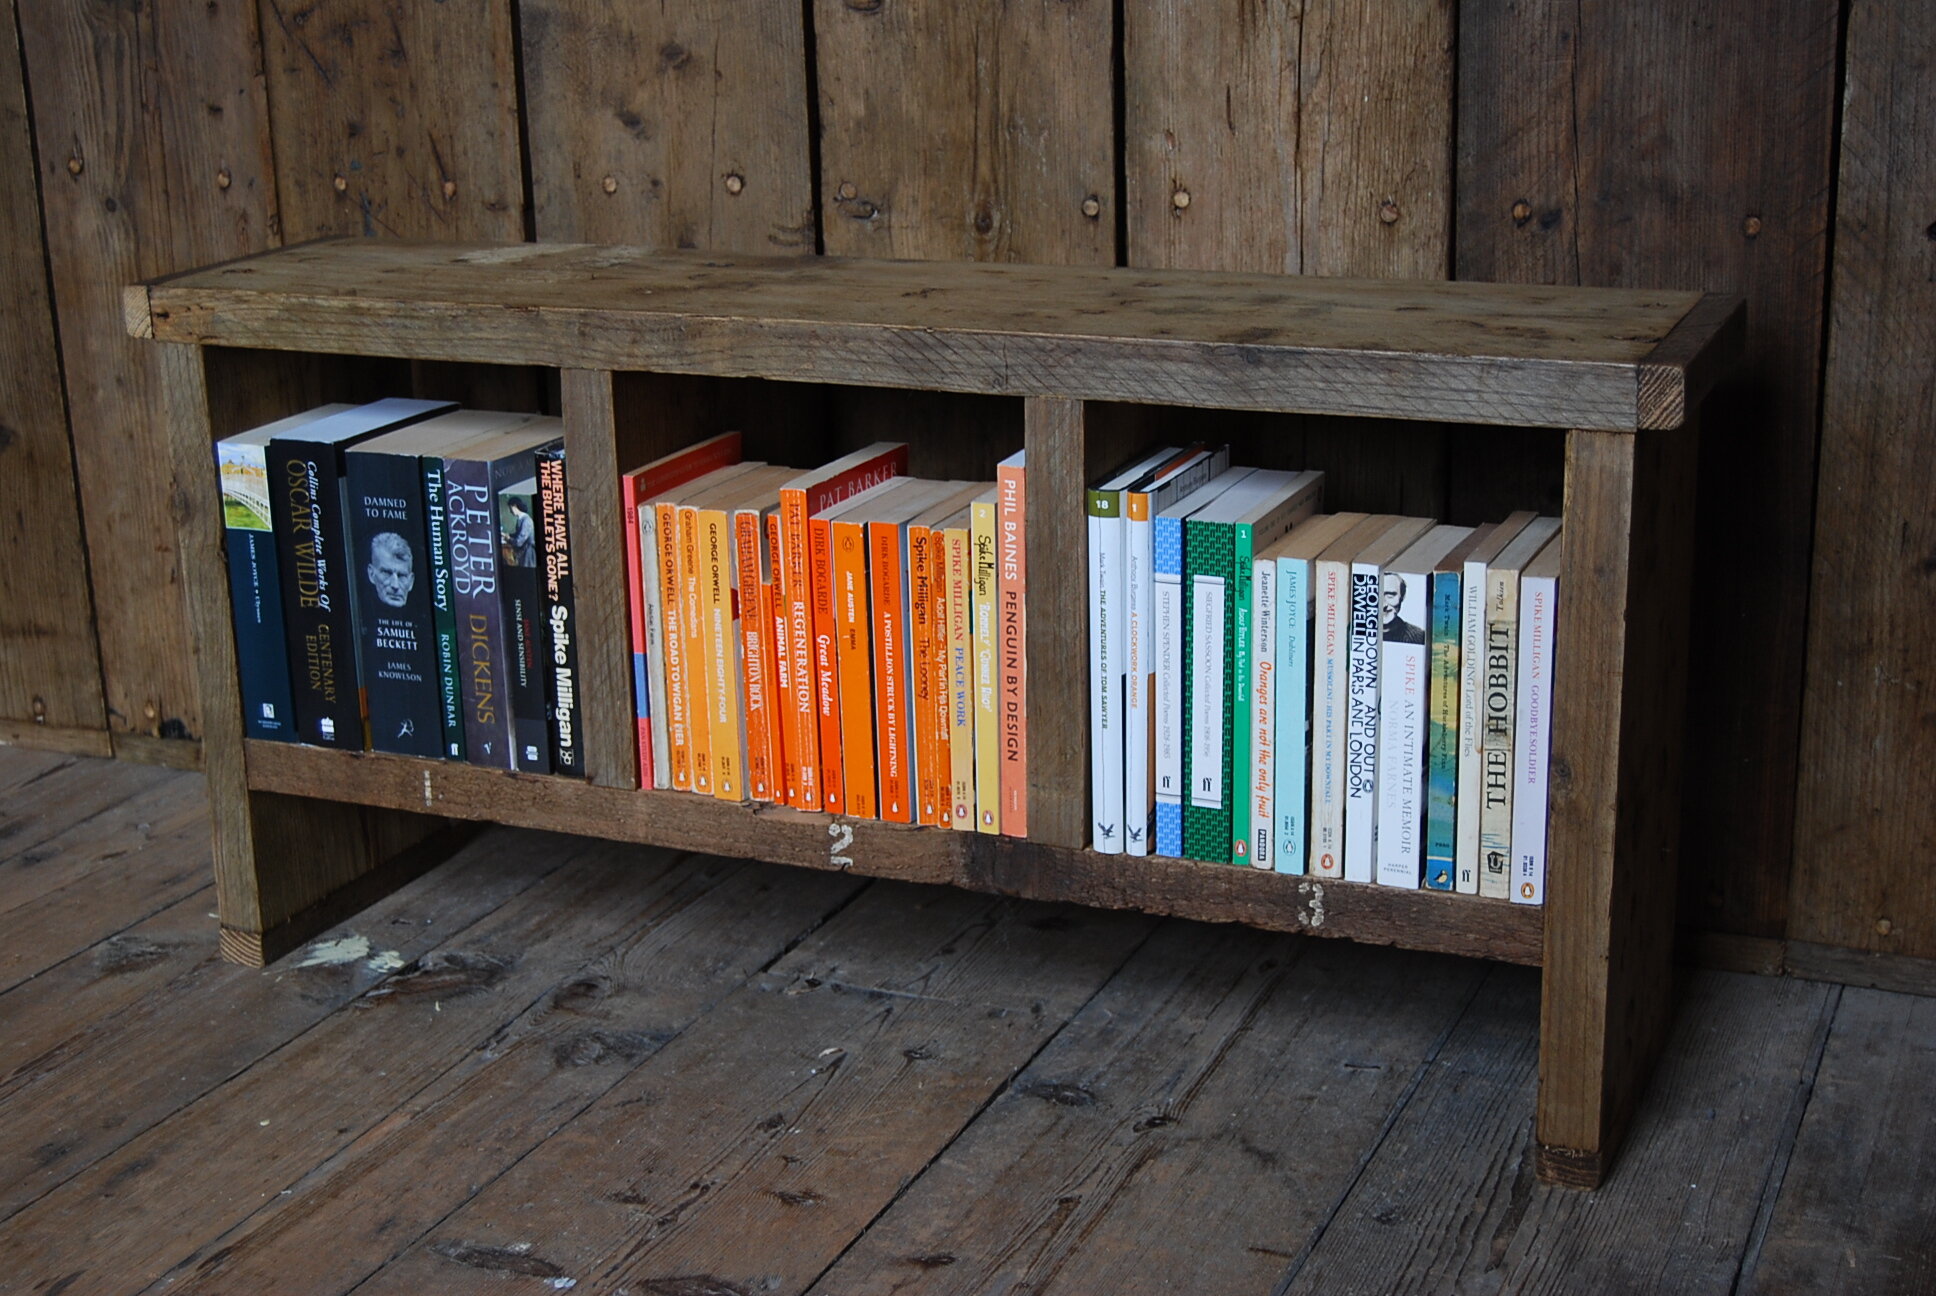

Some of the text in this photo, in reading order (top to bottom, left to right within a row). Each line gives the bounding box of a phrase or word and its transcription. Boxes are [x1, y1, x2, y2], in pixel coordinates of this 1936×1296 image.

[364, 496, 407, 509] DAMNED
[820, 462, 897, 511] PAT BARKER
[1096, 500, 1109, 510] 18
[287, 460, 321, 608] OSCAR WILDE
[307, 461, 332, 612] Collins Complete Works Of
[365, 508, 408, 520] TO FAME
[428, 469, 449, 612] The Human Story
[448, 480, 471, 595] ACKROYD
[540, 460, 559, 601] THE BULLETS GONE?
[550, 460, 569, 579] WHERE HAVE ALL
[662, 513, 674, 557] GEORGE
[464, 484, 496, 600] PETER
[881, 536, 889, 560] DIRK
[974, 535, 995, 596] Spike Milligan
[666, 560, 675, 605] ORWELL
[684, 511, 698, 638] Graham Greene The Comedians
[846, 571, 854, 591] JANE
[882, 561, 891, 606] BOGARDE
[1496, 582, 1505, 612] Tolkien
[668, 610, 678, 631] THE
[710, 523, 727, 723] GEORGE ORWELL NINETEEN EIGHTY-FOUR
[740, 521, 763, 712] GRAHAM GREENE BRIGHTON ROCK
[770, 523, 789, 688] GEORGE ORWELL ANIMAL FARM
[789, 504, 811, 713] PAT BARKER REGENERATION
[814, 528, 834, 716] DIRK BOGARDE Great Meadow
[847, 592, 855, 623] AUSTEN
[914, 536, 930, 700] Spike Milligan The Looney
[952, 538, 966, 727] SPIKE MILLIGAN PEACE WORK
[1004, 480, 1019, 762] PHIL BAINES PENGUIN BY DESIGN
[1162, 592, 1170, 630] STEPHEN
[1205, 592, 1213, 634] SIEGFRIED
[1286, 570, 1297, 668] JAMES JOYCE Dubliners
[376, 638, 419, 651] BECKETT
[377, 627, 416, 640] SAMUEL
[514, 600, 527, 688] SENSE AND SENSIBILITY
[669, 633, 680, 665] ROAD
[884, 620, 894, 675] POSTILLION
[1100, 608, 1108, 661] ADVENTURES
[1162, 630, 1171, 672] SPENDER
[1204, 634, 1213, 675] SASSOON
[1353, 637, 1365, 653] IN
[306, 635, 321, 692] EDITION
[318, 624, 337, 704] CENTENARY
[378, 671, 422, 682] KNOWLSON
[387, 662, 412, 671] JAMES
[440, 634, 457, 727] ROBIN DUNBAR
[468, 614, 496, 724] DICKENS
[550, 606, 574, 747] Spike Milligan
[672, 666, 680, 681] TO
[1101, 662, 1108, 674] OF
[1163, 672, 1171, 702] Collected
[1204, 674, 1212, 703] Collected
[1364, 574, 1379, 775] GEORGE DOWN AND OUT
[1464, 586, 1478, 758] WILLIAM GOLDING Lord of the Flies
[1528, 592, 1543, 784] SPIKE MILLIGAN GOODBYE SOLDIER
[672, 682, 682, 720] WIGAN
[886, 676, 895, 712] STRUCK
[886, 713, 896, 726] BY
[1256, 572, 1273, 818] Jeanette Winterson Oranges are not the only fruit
[1486, 622, 1509, 810] THE HOBBIT
[674, 724, 685, 746] PIER
[888, 727, 898, 777] LIGHTNING
[1386, 700, 1398, 809] NORMA FARNES
[1401, 656, 1416, 854] SPIKE AN INTIMATE MEMOIR
[1350, 732, 1363, 799] LONDON
[828, 823, 854, 871] 2
